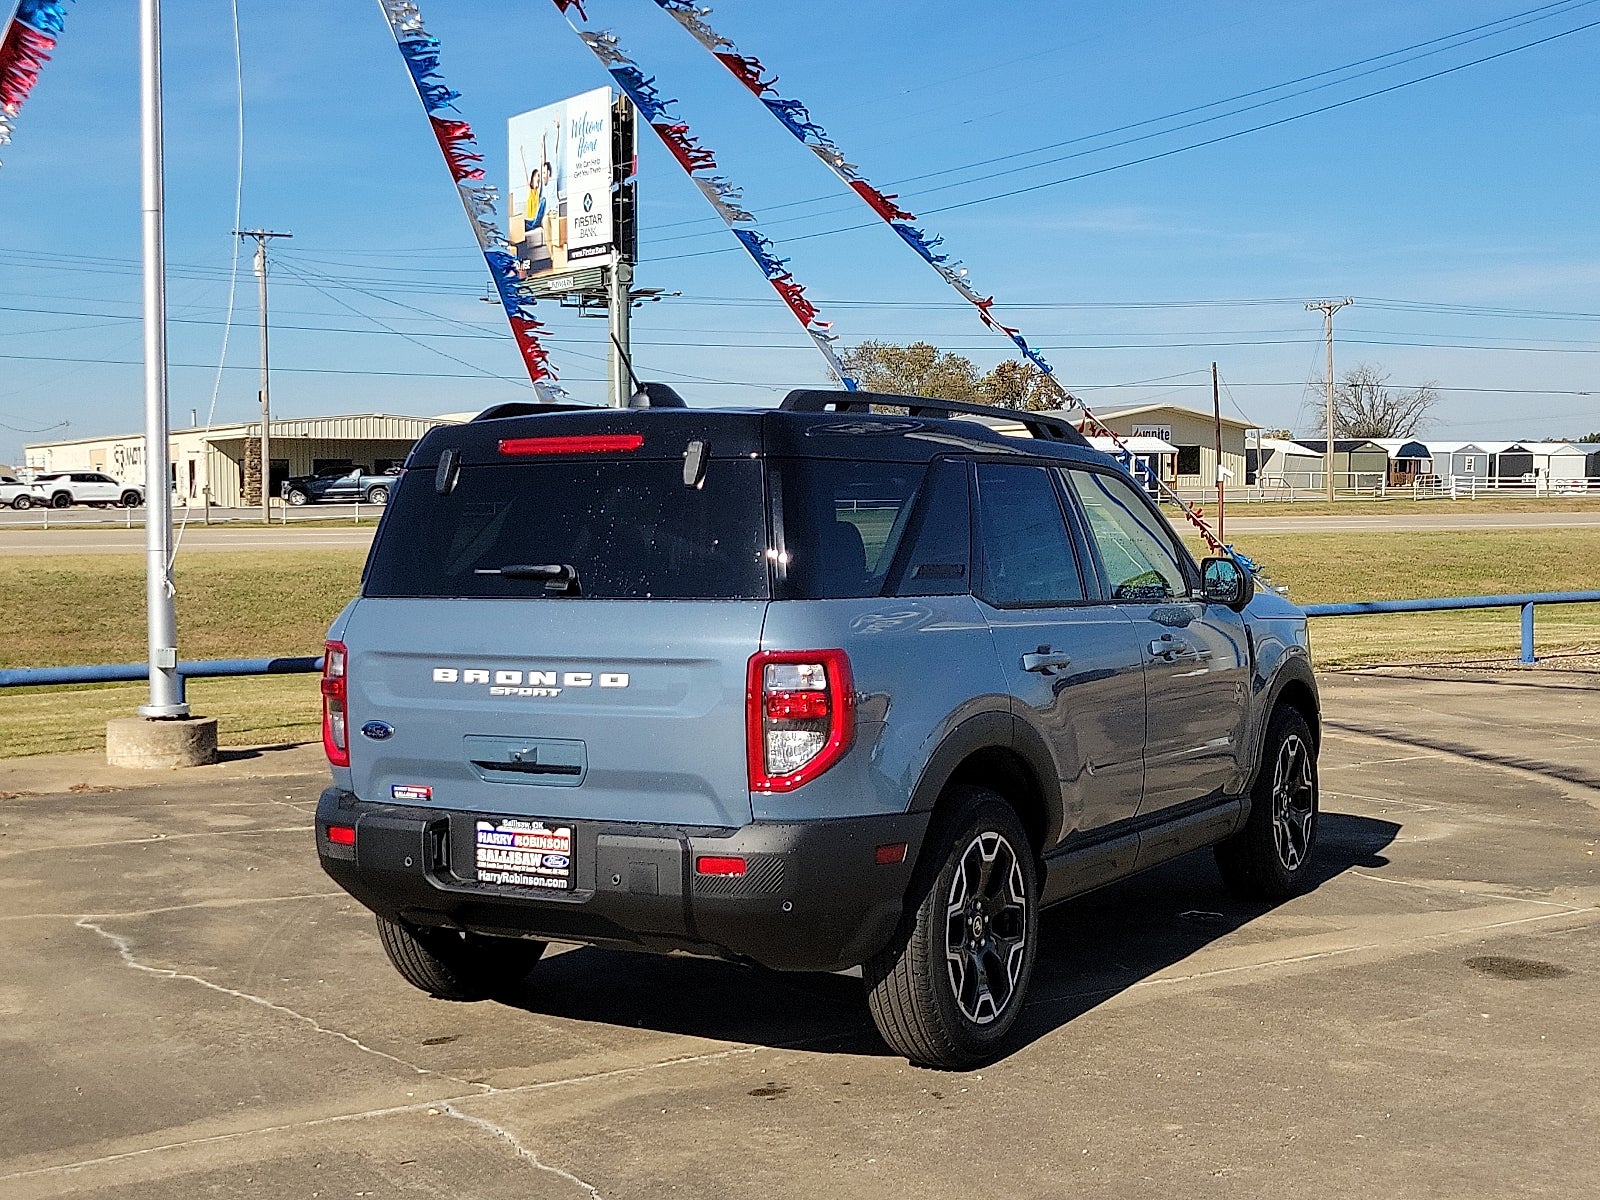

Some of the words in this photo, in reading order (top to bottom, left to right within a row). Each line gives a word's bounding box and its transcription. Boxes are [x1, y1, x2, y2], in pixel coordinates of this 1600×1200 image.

[571, 111, 604, 139] Welcome
[574, 213, 603, 230] FIRSTAR
[578, 226, 598, 239] BANK
[432, 667, 630, 689] BRONCO
[489, 686, 563, 698] SPORT
[532, 821, 545, 830] OK
[477, 831, 514, 846] HARRY
[514, 835, 570, 852] ROBINSON
[476, 848, 543, 867] SALLISAW
[477, 869, 568, 889] HarryRobinson.com
